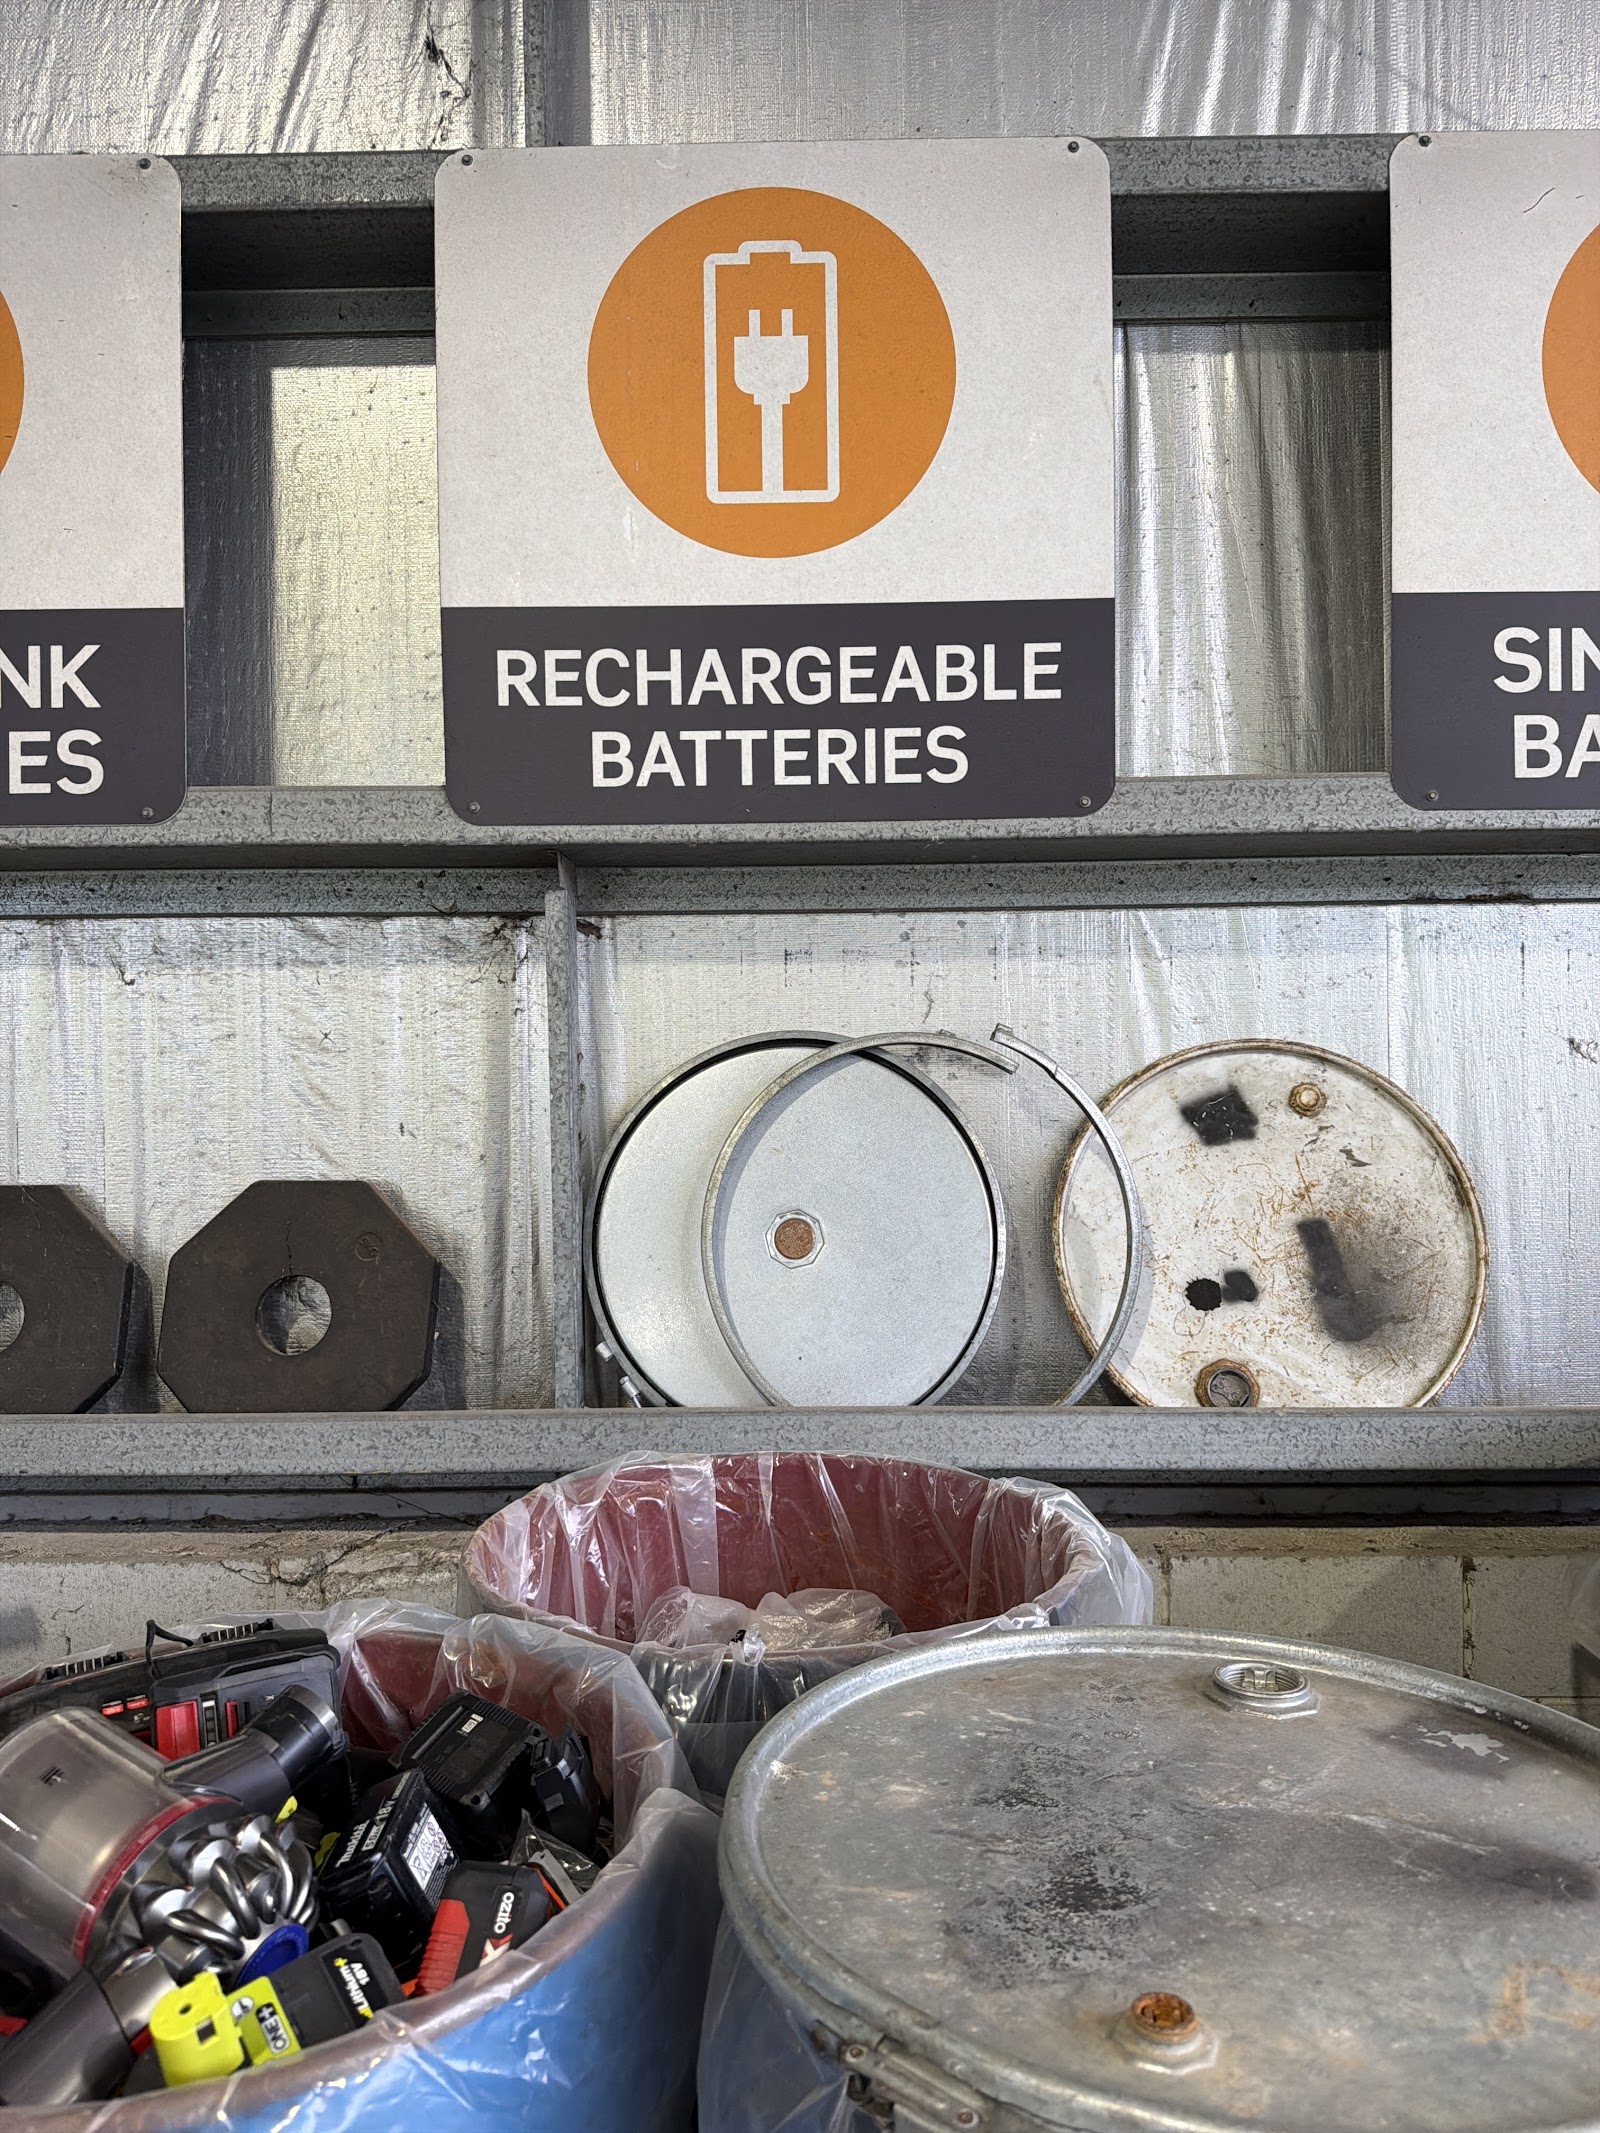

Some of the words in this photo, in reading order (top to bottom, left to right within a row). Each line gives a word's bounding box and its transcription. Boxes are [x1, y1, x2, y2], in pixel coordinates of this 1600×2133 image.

[496, 642, 1062, 707] RECHARGEABLE
[8, 728, 104, 795] ES
[591, 725, 969, 788] BATTERIES
[336, 1820, 371, 1867] makita
[494, 1891, 515, 1934] ozito
[350, 1962, 371, 1986] 18V
